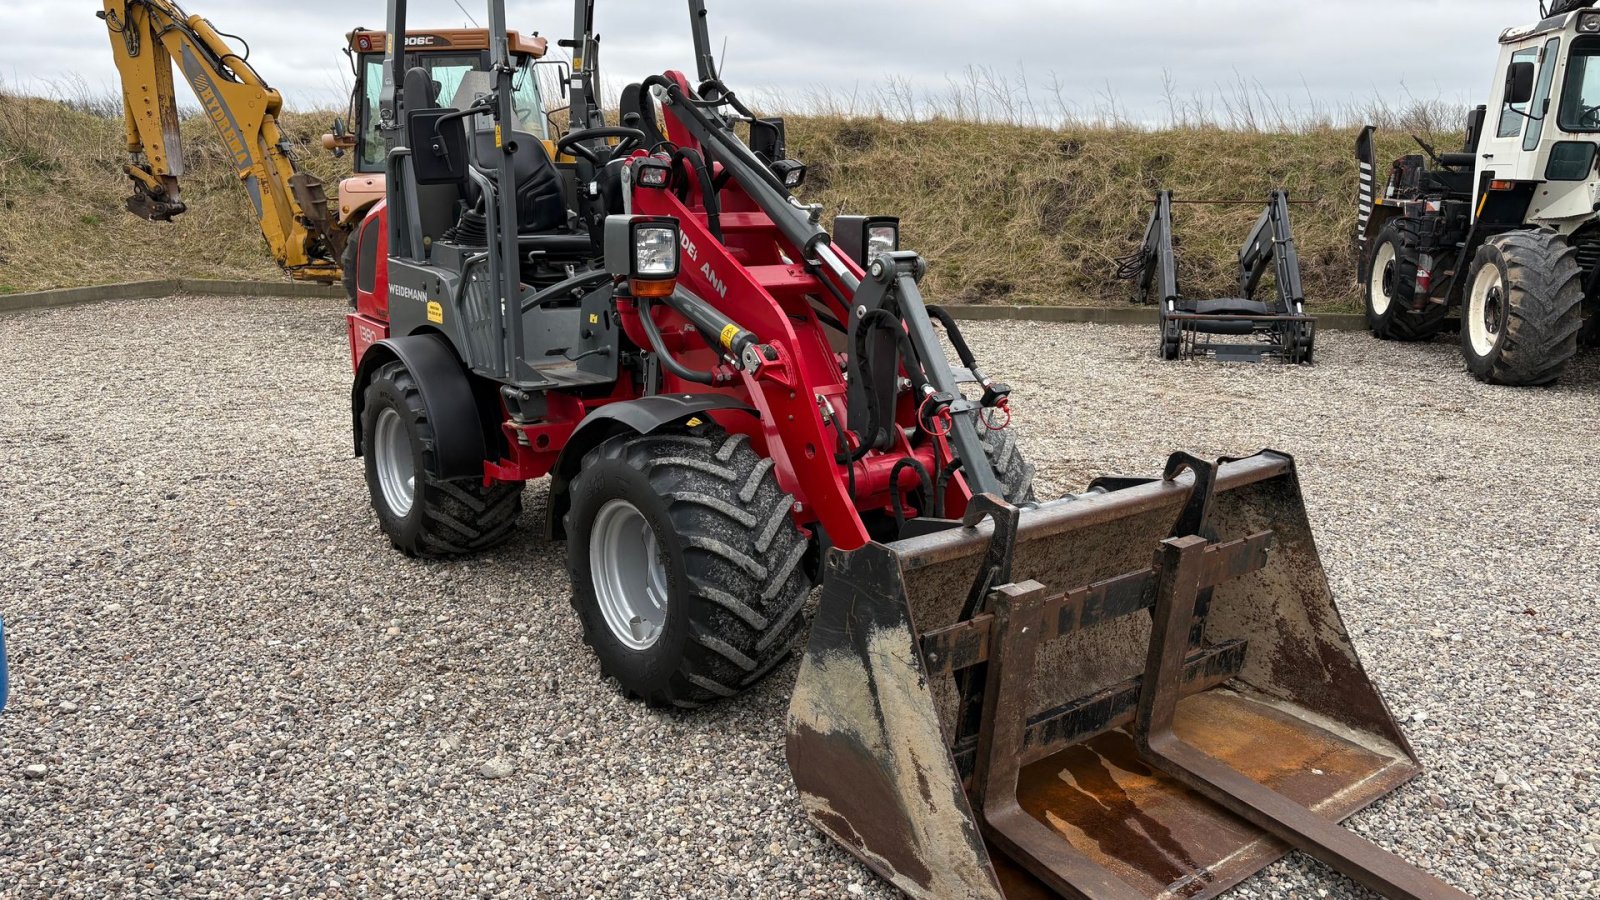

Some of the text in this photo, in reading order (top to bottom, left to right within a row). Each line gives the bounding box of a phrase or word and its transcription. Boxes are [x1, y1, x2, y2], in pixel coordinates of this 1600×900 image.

[200, 85, 249, 165] HYDREMA
[388, 283, 428, 303] WEIDEMANN
[358, 324, 377, 344] 1380
